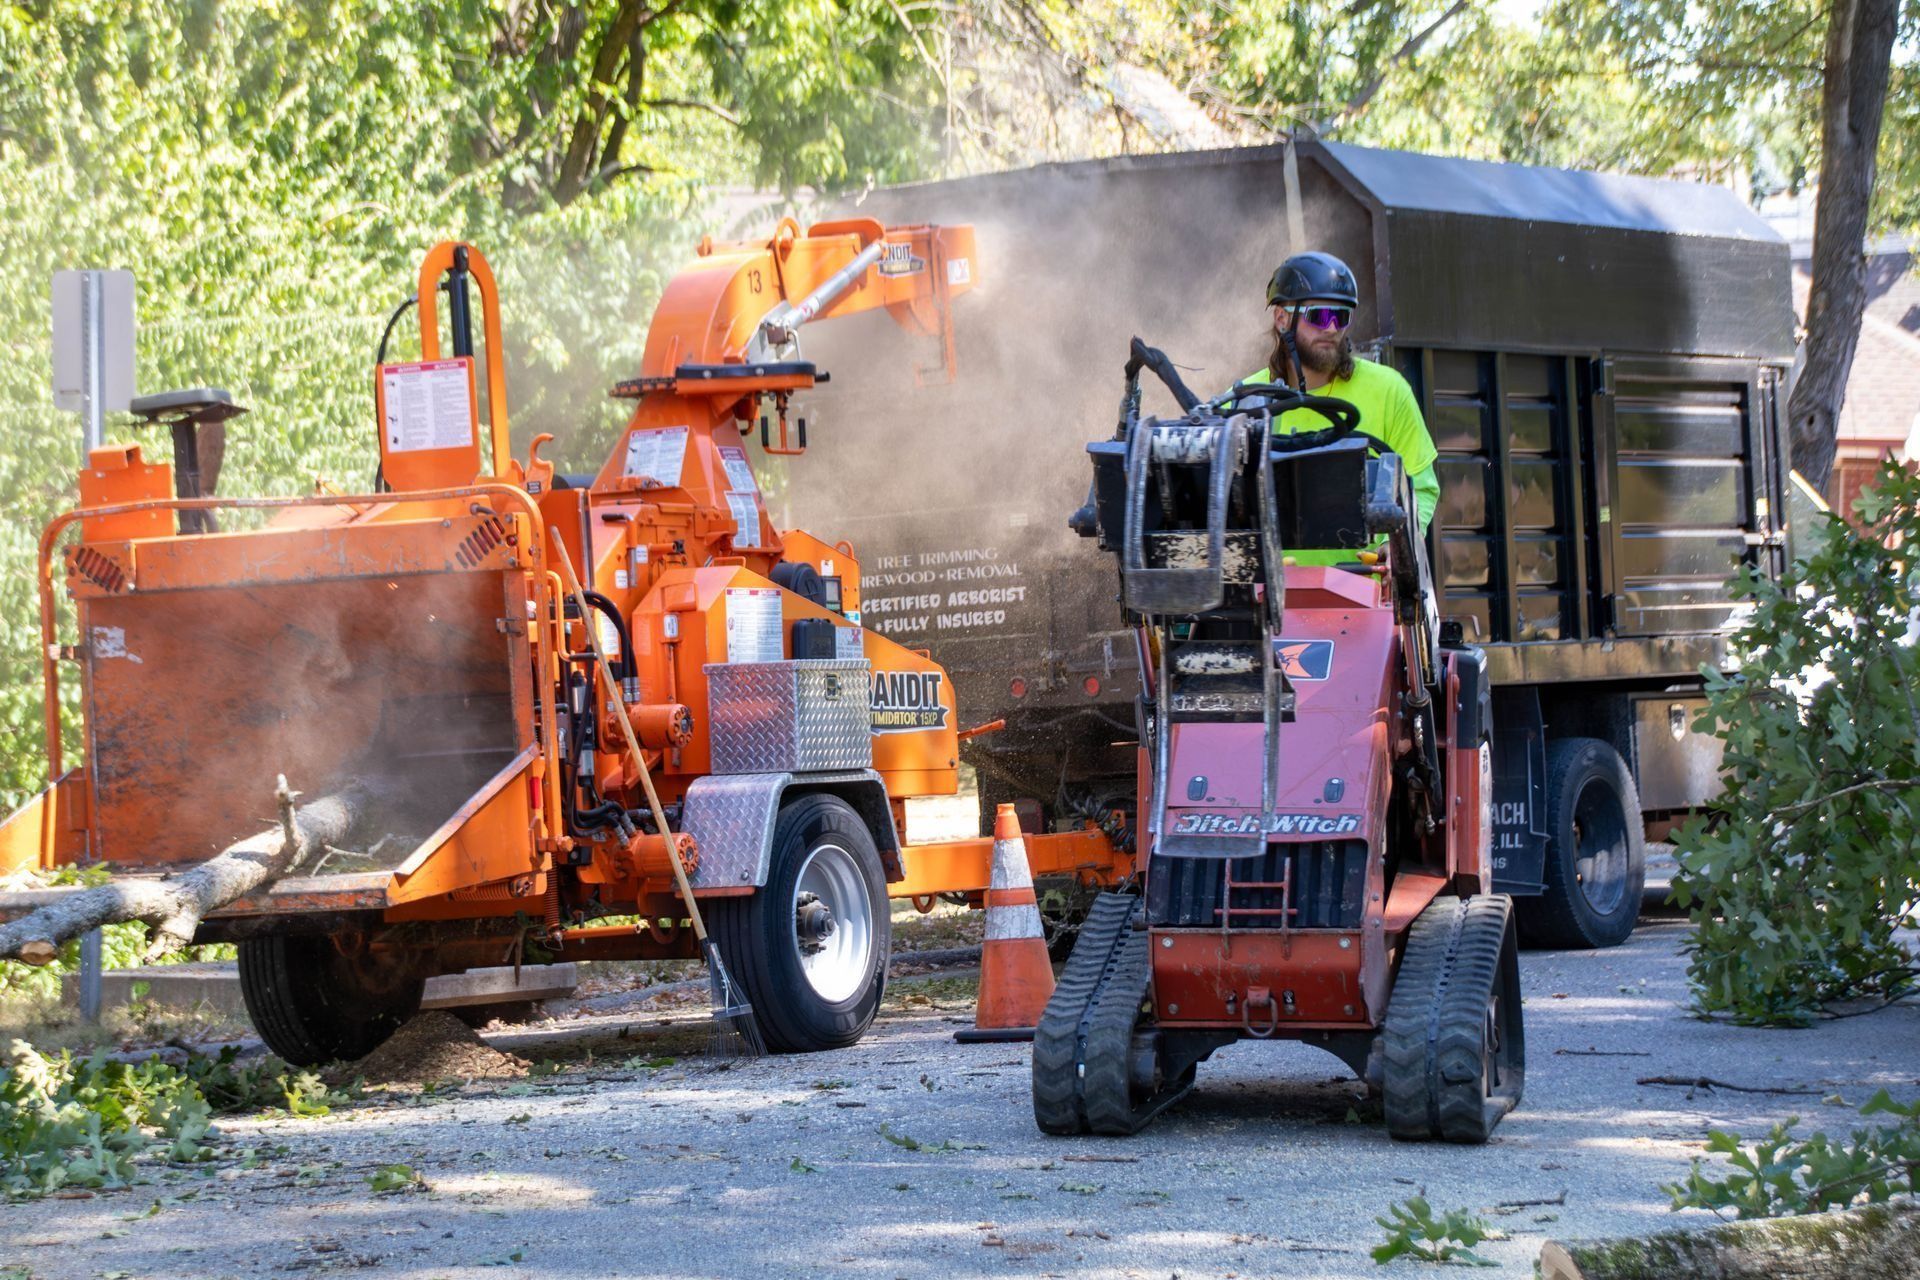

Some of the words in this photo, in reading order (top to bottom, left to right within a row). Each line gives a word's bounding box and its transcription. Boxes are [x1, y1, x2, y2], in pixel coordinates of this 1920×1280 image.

[747, 270, 762, 293] 13
[877, 554, 913, 570] TREE
[919, 547, 998, 567] TRIMMING
[861, 569, 936, 588] IREWOOD
[946, 563, 1023, 582] REMOVAL
[861, 593, 941, 614] CERTIFIED
[948, 586, 1027, 607] ARBORIST
[936, 609, 1006, 629] INSURED
[870, 711, 917, 725] TIMIDATOR
[920, 711, 938, 726] 15XP
[1175, 813, 1261, 833] Ditch
[1271, 814, 1359, 833] Witch
[1501, 832, 1524, 849] ILL
[1491, 857, 1507, 870] NS
